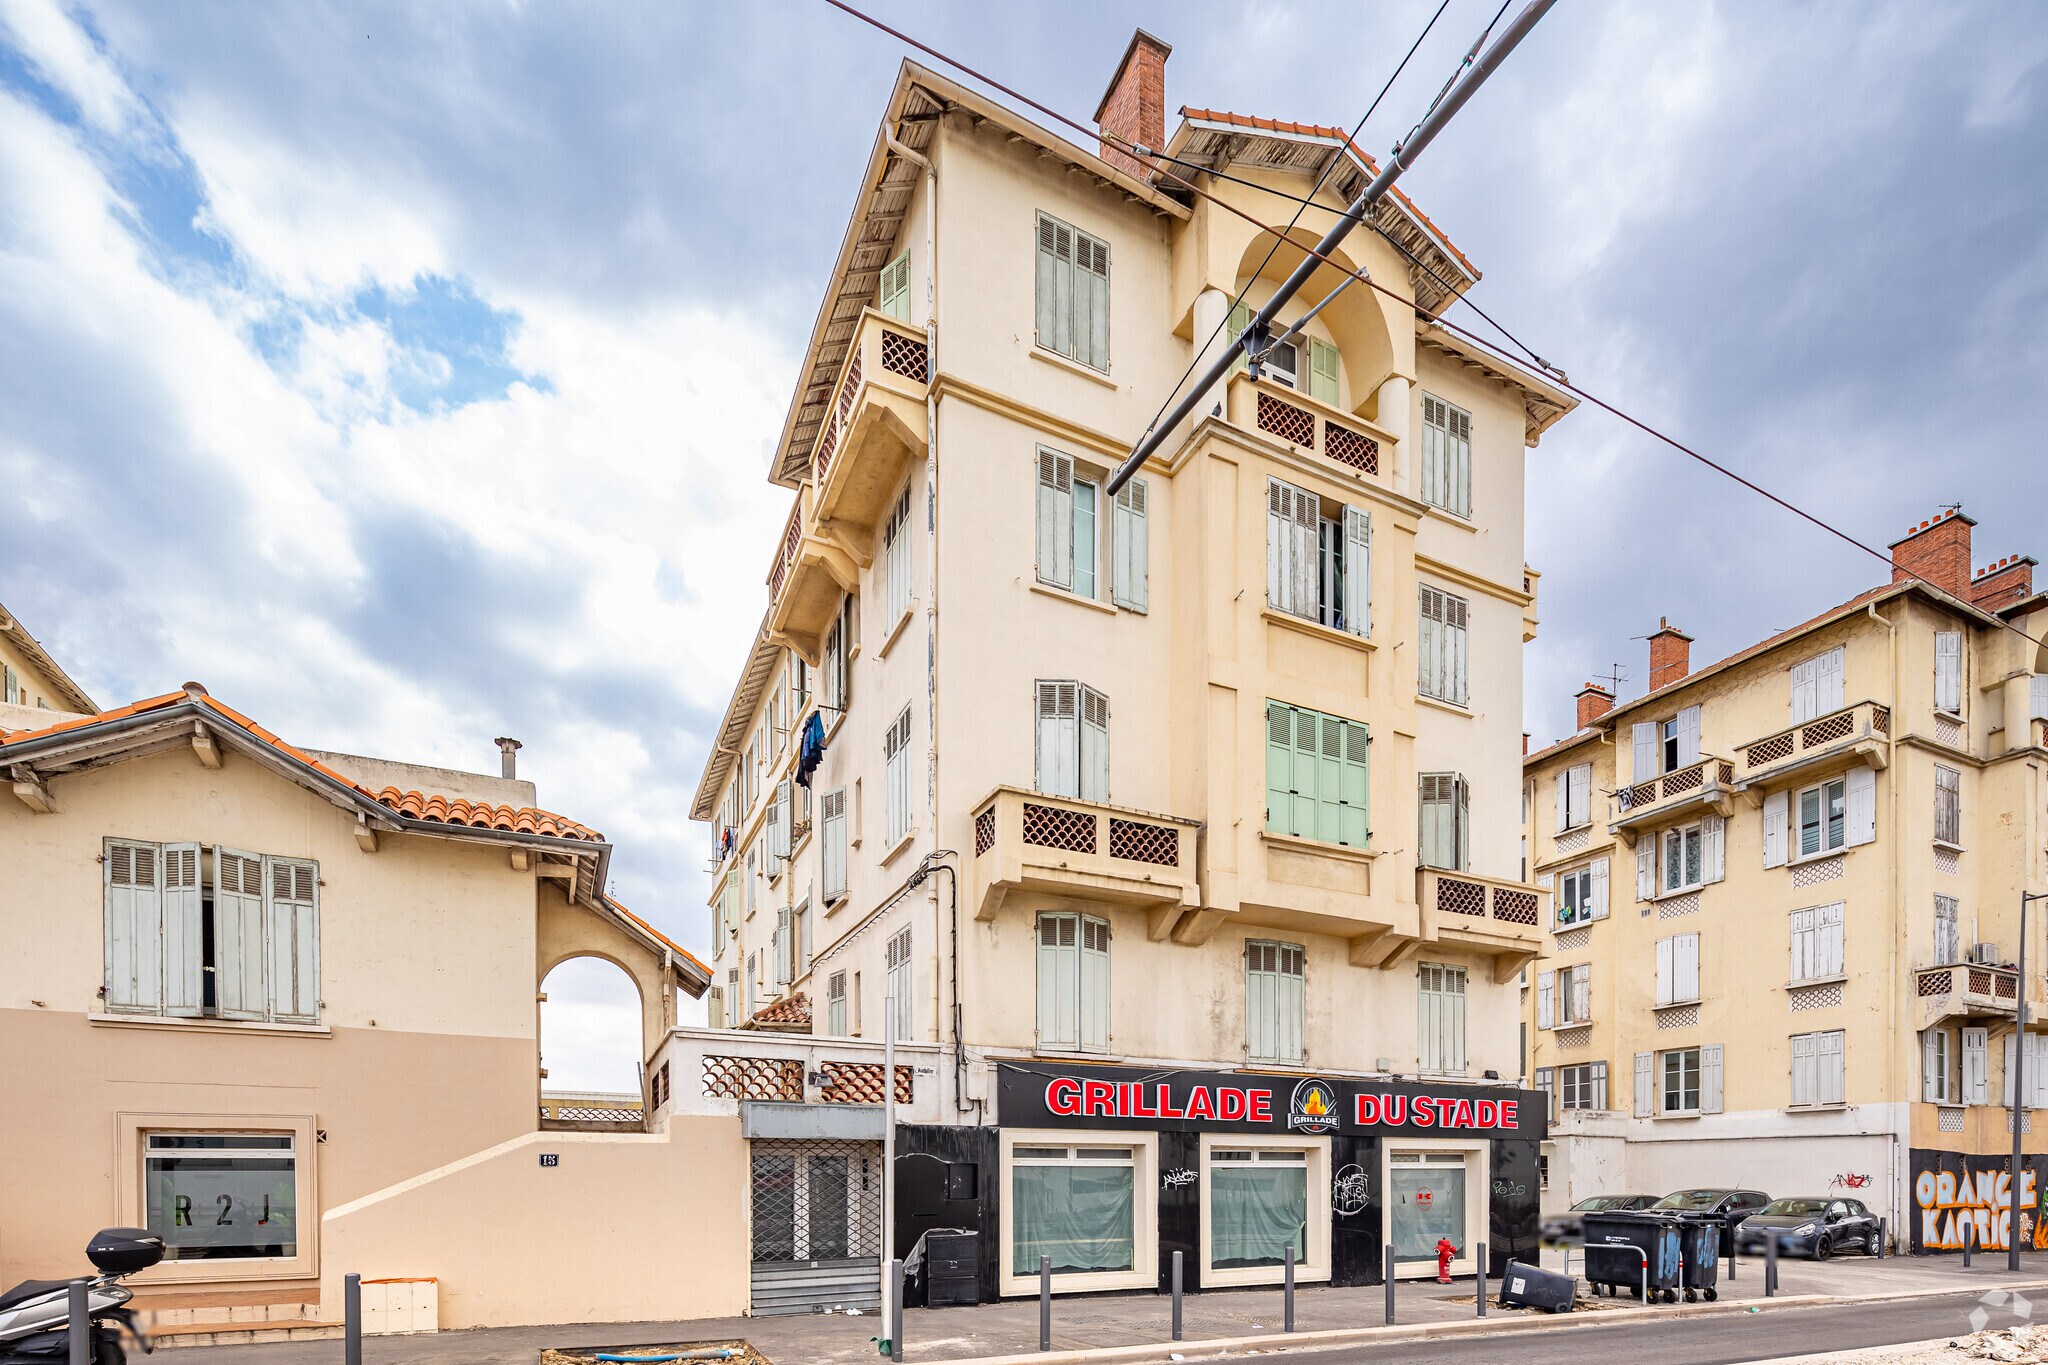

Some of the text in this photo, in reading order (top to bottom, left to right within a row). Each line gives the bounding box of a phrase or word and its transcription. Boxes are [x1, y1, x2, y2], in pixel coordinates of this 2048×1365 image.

[1045, 1077, 1519, 1130] GRILLADE DU STADE
[1293, 1116, 1338, 1126] GRILLADE
